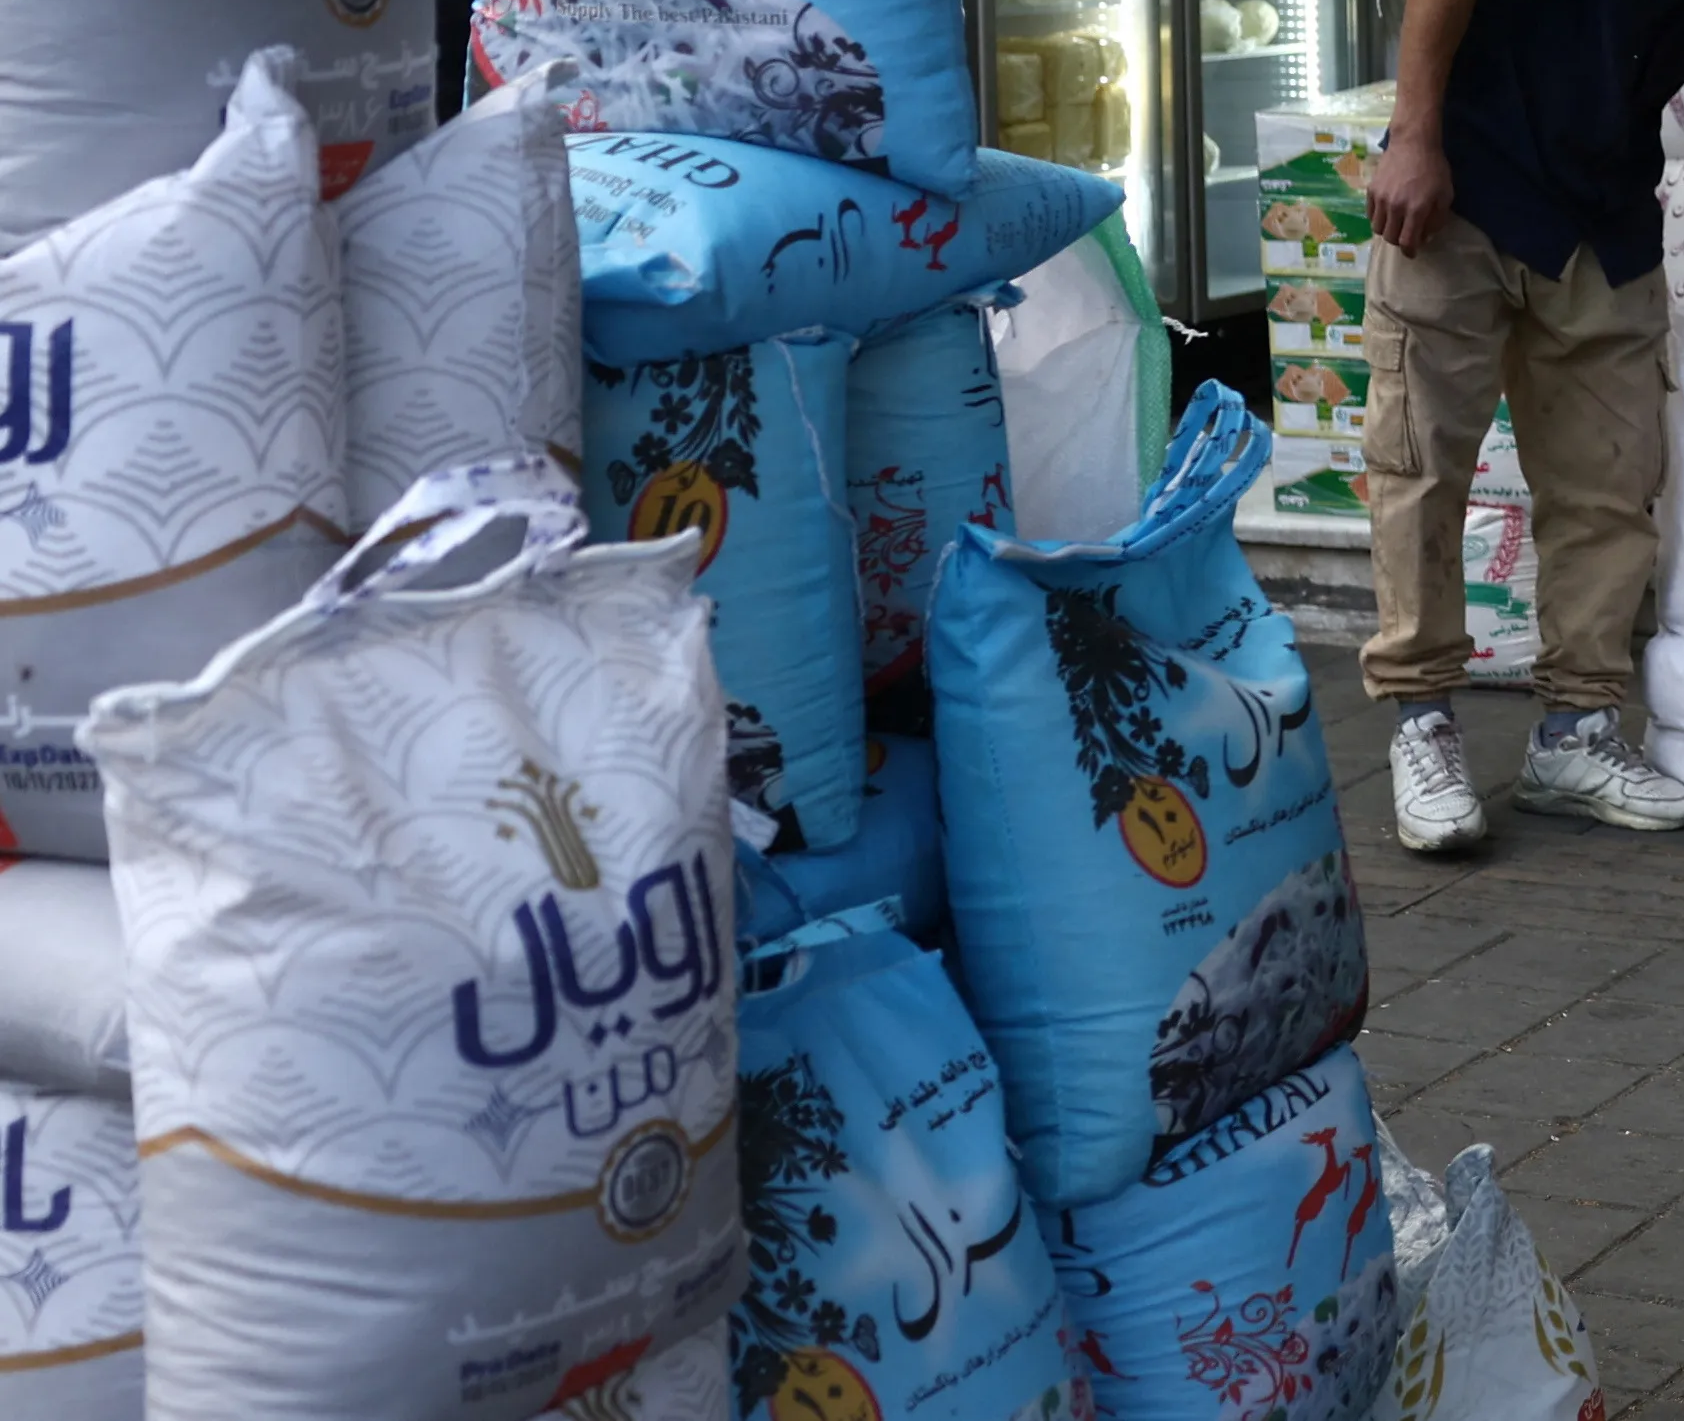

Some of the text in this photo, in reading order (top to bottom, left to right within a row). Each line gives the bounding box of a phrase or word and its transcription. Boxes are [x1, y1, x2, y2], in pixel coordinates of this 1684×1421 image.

[619, 3, 651, 21] The
[658, 5, 696, 23] best
[701, 5, 788, 26] Pakistani
[452, 850, 725, 1067] رویال
